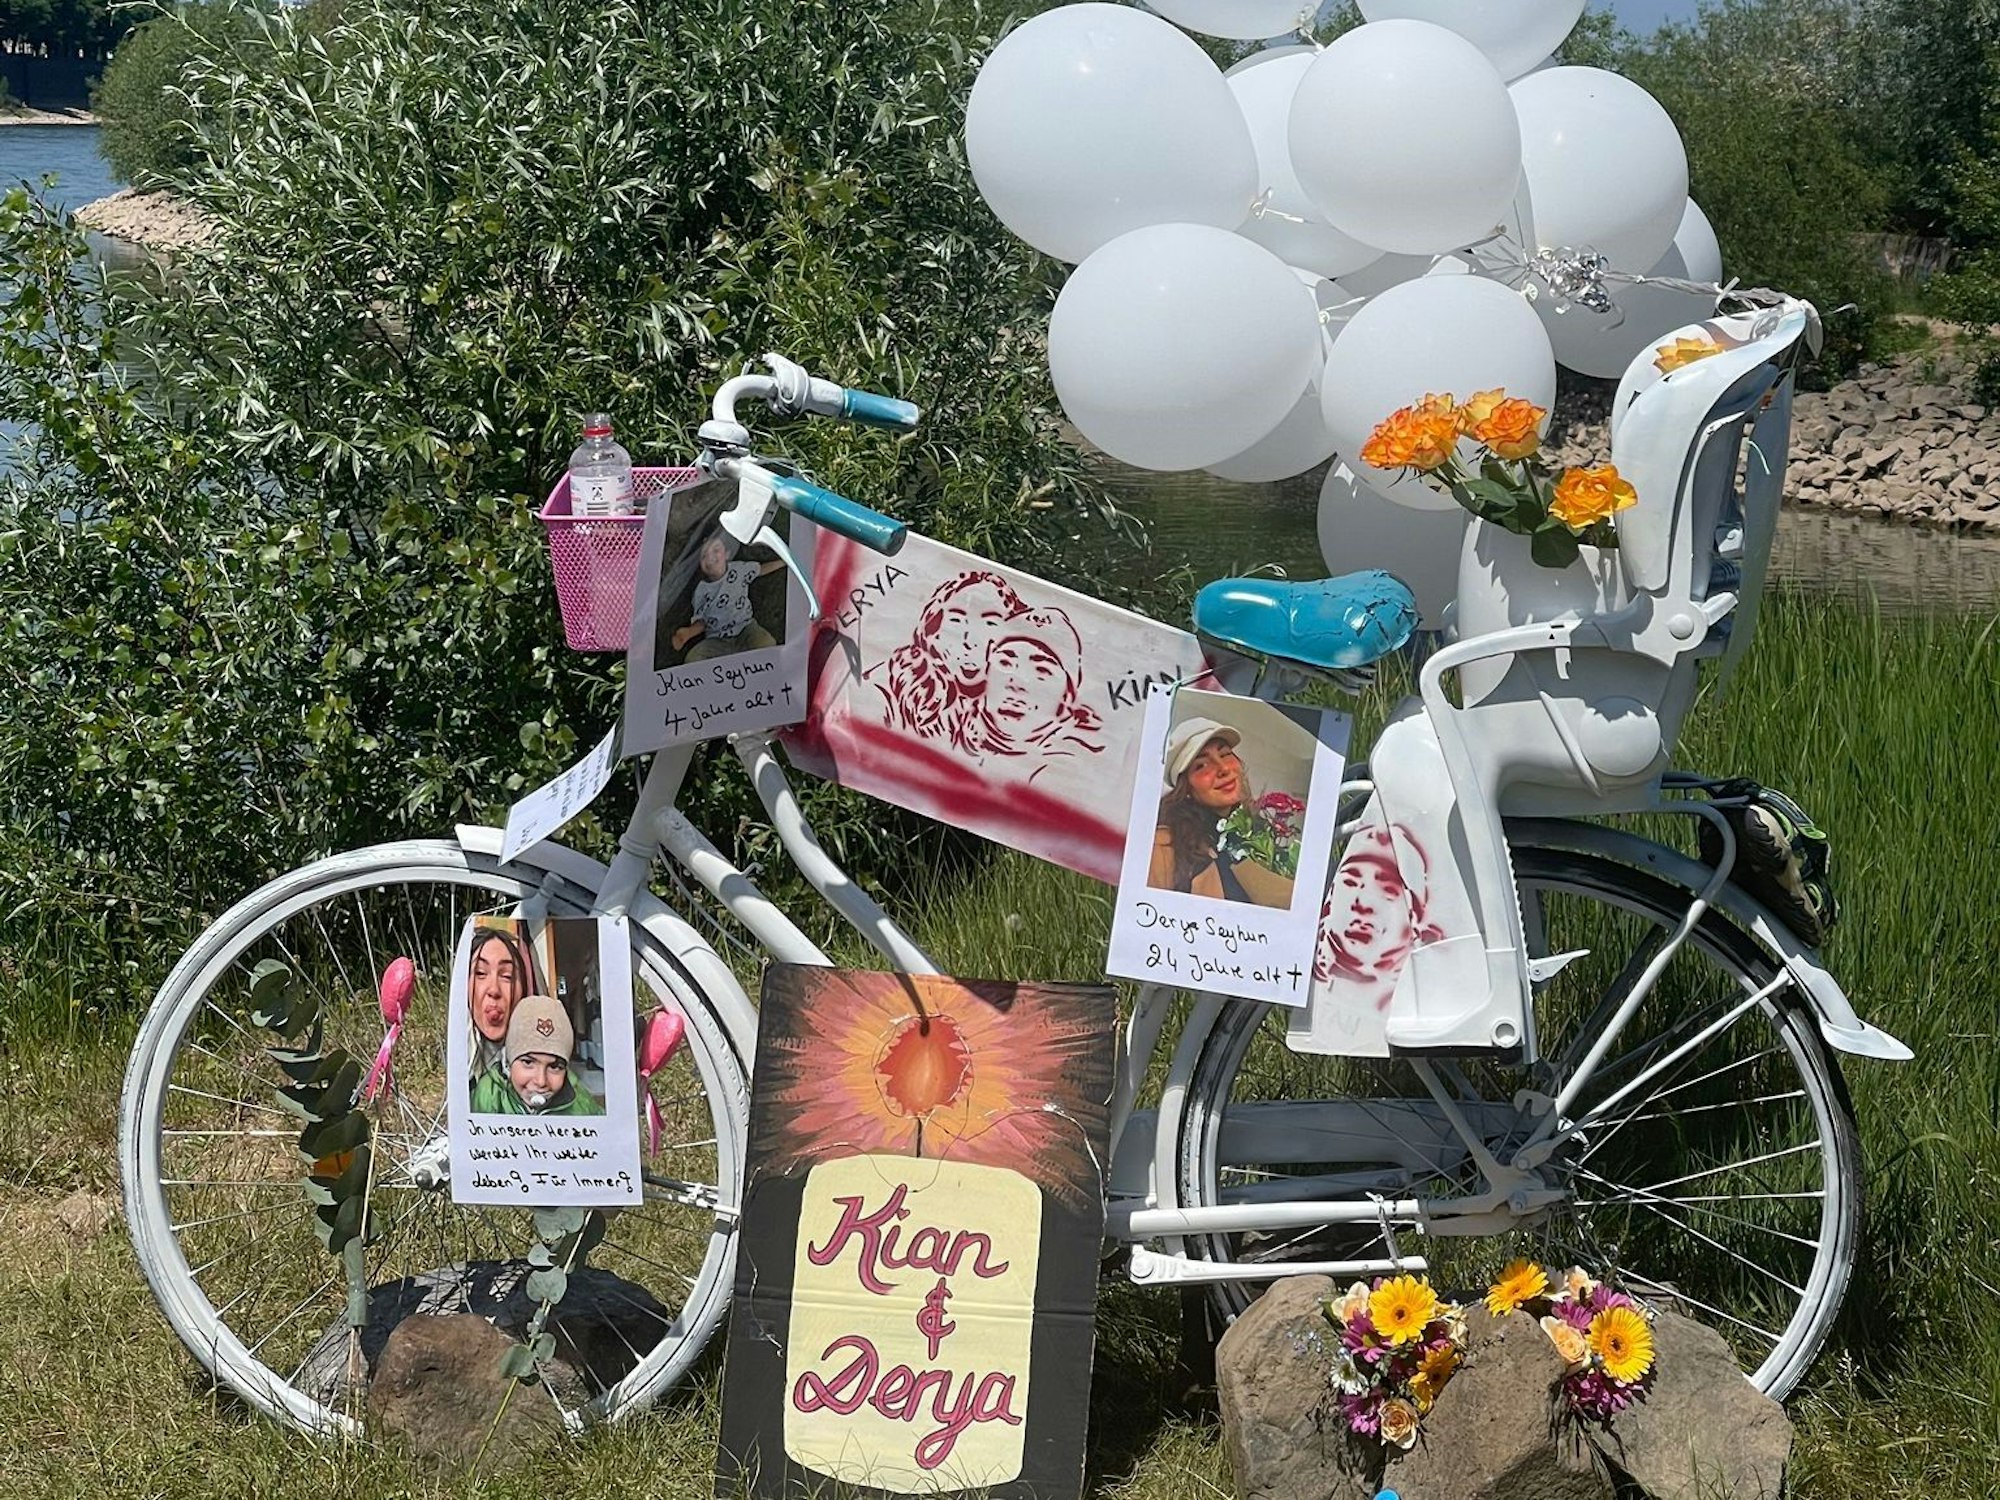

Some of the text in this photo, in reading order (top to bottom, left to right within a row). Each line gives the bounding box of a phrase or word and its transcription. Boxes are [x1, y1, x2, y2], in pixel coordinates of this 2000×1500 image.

[712, 662, 775, 690] Seyhun
[665, 709, 687, 736] 4
[691, 704, 735, 730] Jahre
[745, 690, 775, 709] alt
[1205, 916, 1268, 954] Seyhun
[1146, 943, 1178, 973] 24
[1189, 953, 1244, 982] Jahre
[1253, 966, 1281, 985] alt
[488, 1125, 542, 1138] unseren
[544, 1123, 598, 1138] Herzen
[469, 1144, 598, 1161] werdet Ihr weiter
[807, 1183, 1010, 1296] Kian
[916, 1277, 957, 1361] &
[793, 1335, 1023, 1471] Derya
